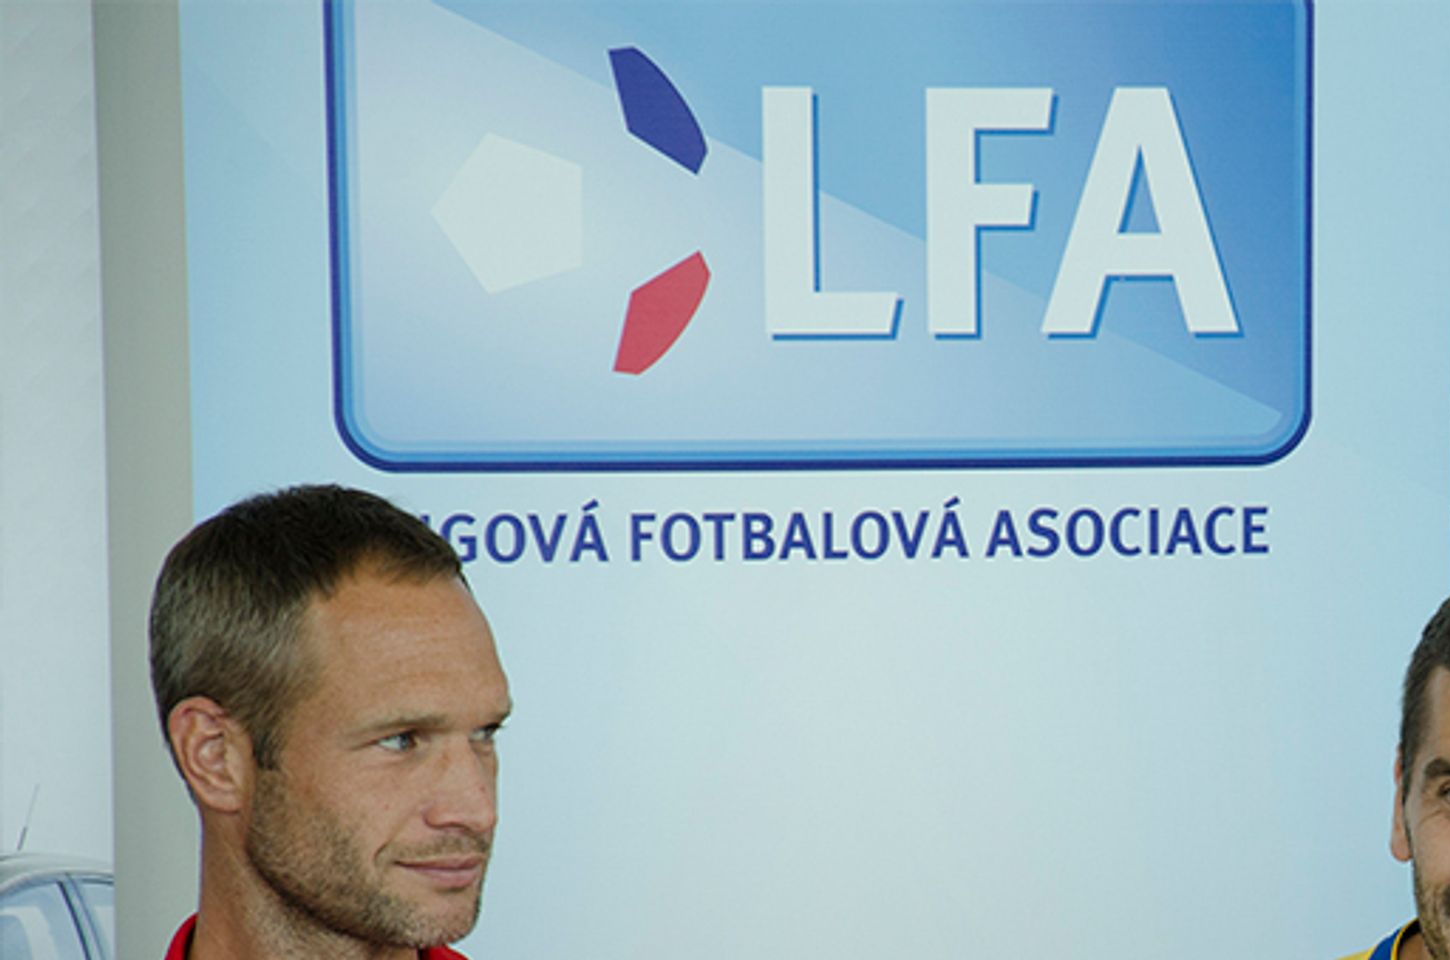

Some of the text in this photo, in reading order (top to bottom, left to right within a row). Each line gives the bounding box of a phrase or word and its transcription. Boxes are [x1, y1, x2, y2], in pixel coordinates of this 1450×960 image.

[762, 86, 1243, 340] LFA
[420, 496, 1271, 563] GOVÁ FOTBALOVÁ ASOCIACE
